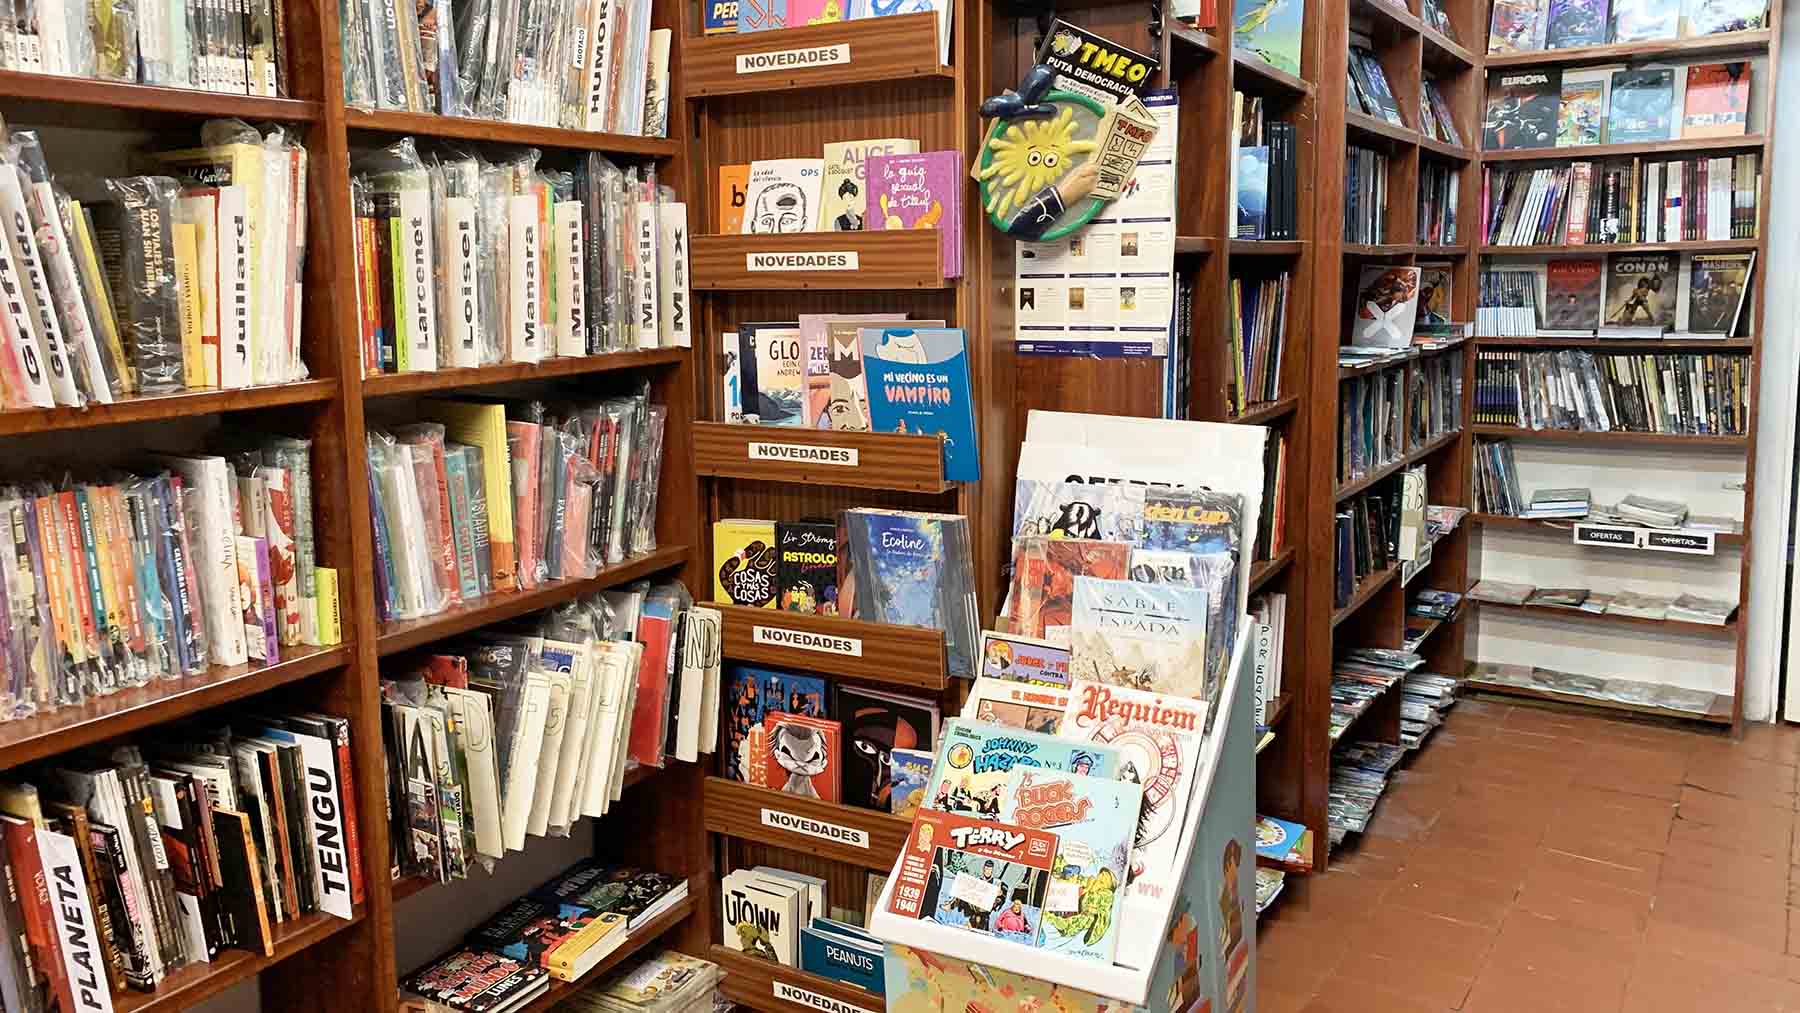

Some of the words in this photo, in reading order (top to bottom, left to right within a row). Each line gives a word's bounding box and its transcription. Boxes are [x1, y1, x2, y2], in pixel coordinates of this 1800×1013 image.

[576, 29, 585, 65] AGOTADO
[591, 0, 608, 113] HUMOR
[744, 49, 839, 69] NOVEDADES
[1080, 42, 1147, 82] TMEO
[1046, 56, 1073, 74] PUTA
[1073, 66, 1134, 96] DEMOCRACIA
[1501, 74, 1548, 87] EUROPA
[800, 168, 819, 177] OPS
[143, 240, 153, 259] SIN
[151, 231, 163, 265] VIAJES
[754, 255, 847, 268] NOVEDADES
[1615, 262, 1669, 274] CONAN
[415, 216, 429, 350] Larcenet
[458, 221, 474, 350] Loisel
[524, 225, 536, 348] Manara
[570, 220, 582, 338] Marini
[640, 220, 654, 330] Martin
[672, 226, 684, 332] Max
[233, 214, 246, 366] Juillard
[926, 374, 936, 383] ES
[936, 375, 948, 384] UN
[884, 384, 951, 406] VAMPIRO
[758, 445, 850, 462] NOVEDADES
[881, 532, 925, 551] Ecoline
[1590, 531, 1623, 541] OFERTAS
[783, 552, 837, 565] ASTROLO
[734, 569, 770, 587] COSAS
[733, 586, 769, 602] COSAS
[761, 629, 853, 652] NOVEDADES
[1259, 625, 1270, 658] POR
[1076, 684, 1198, 732] Requiem
[982, 737, 1038, 754] JOHNNY
[308, 767, 347, 896] TENGU
[769, 812, 861, 843] NOVEDADES
[951, 826, 1026, 850] TERRY
[897, 884, 921, 900] 1939
[895, 898, 917, 913] 1940
[53, 865, 103, 1010] PLANETA
[826, 945, 873, 971] PEANUTS
[486, 975, 523, 997] LUNES
